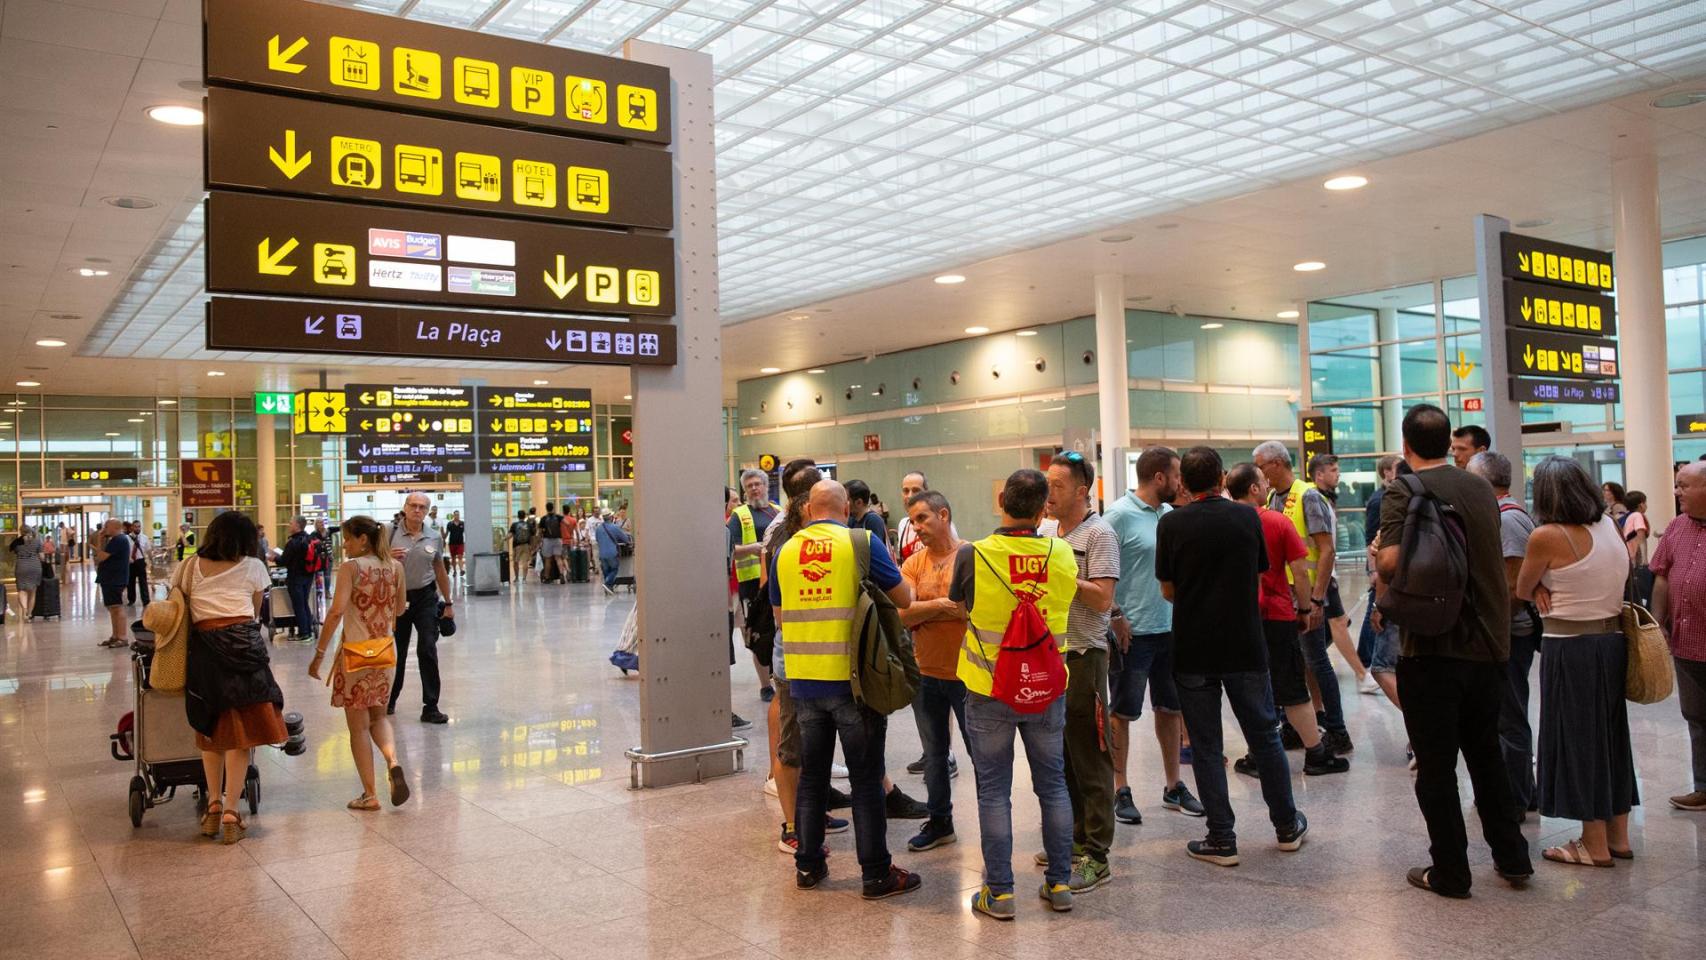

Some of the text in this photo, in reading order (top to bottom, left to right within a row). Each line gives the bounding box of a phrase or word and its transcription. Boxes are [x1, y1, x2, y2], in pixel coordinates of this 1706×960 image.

[523, 72, 543, 84] VIP
[525, 87, 541, 109] P
[340, 141, 373, 152] METRO
[517, 164, 553, 177] HOTEL
[373, 237, 401, 249] AVIS
[406, 234, 438, 246] Budget
[372, 268, 403, 279] Hertz
[596, 273, 611, 296] P
[416, 321, 502, 347] La Plaça
[1467, 400, 1479, 409] 46
[806, 539, 832, 555] UGT
[1015, 557, 1048, 574] UGT
